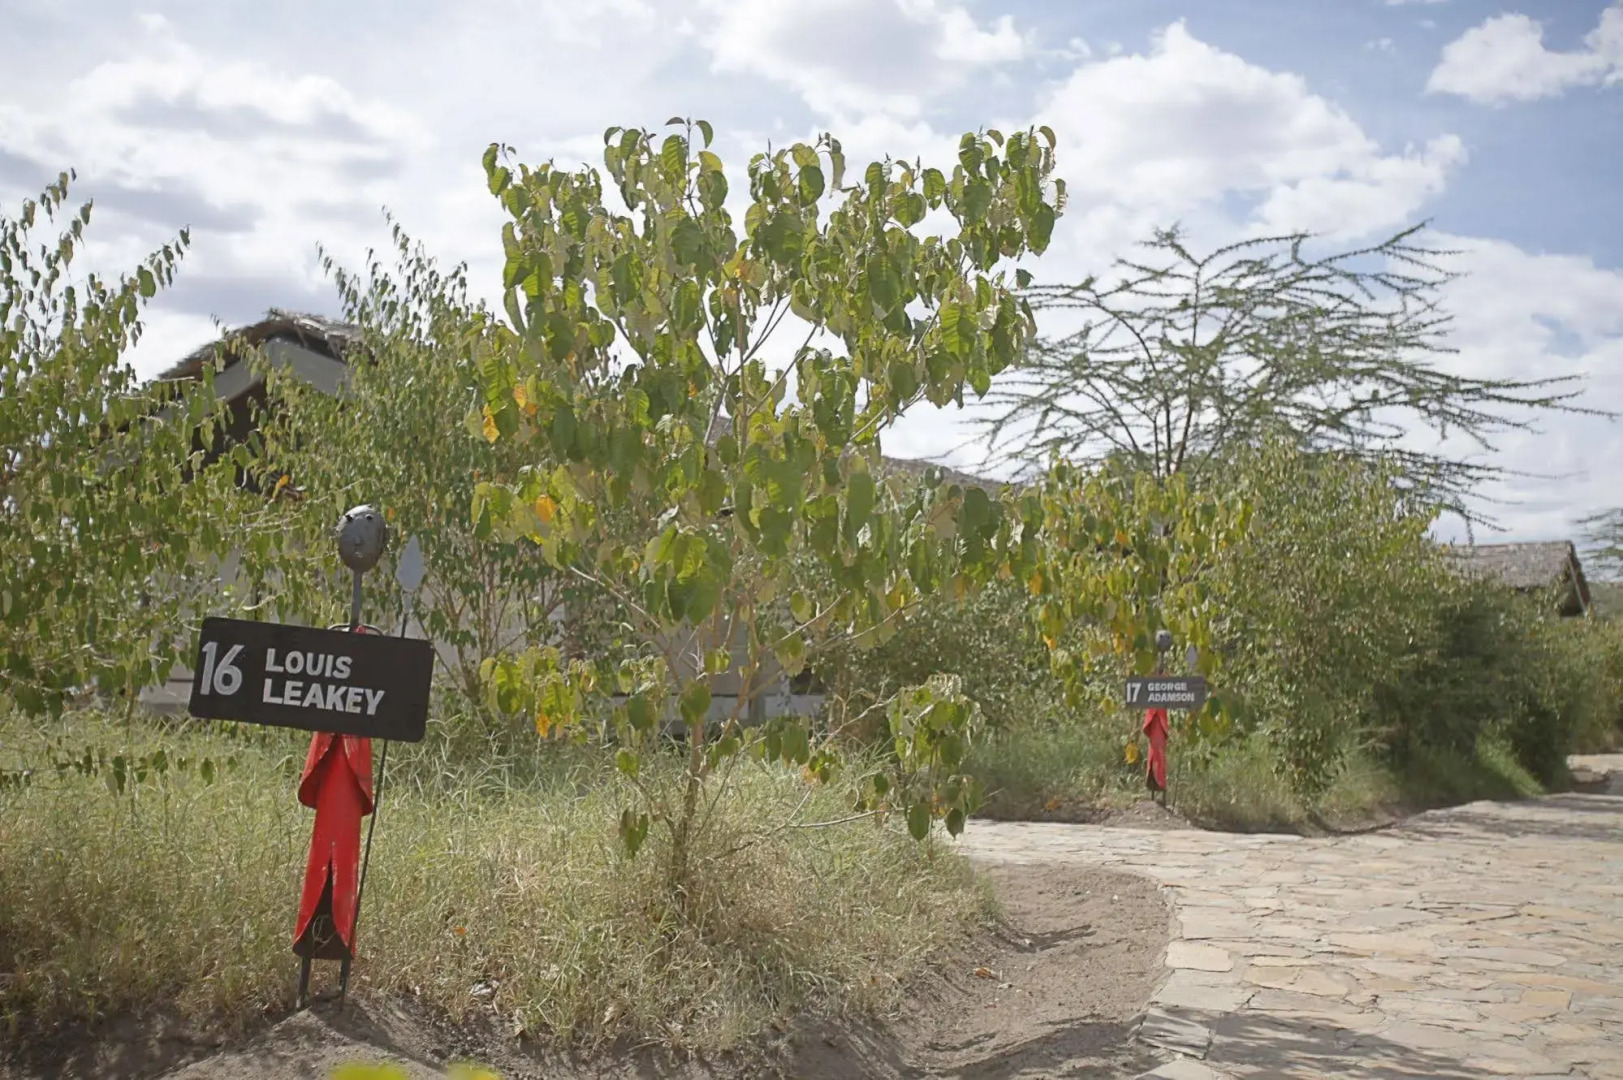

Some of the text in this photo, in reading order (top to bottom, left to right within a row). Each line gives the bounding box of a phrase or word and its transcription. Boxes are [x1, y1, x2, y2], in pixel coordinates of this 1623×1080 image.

[200, 641, 245, 696] 16
[265, 648, 353, 679] LOUIS
[262, 678, 385, 716] LEAKEY
[1126, 682, 1142, 703] 17
[1147, 682, 1187, 691] GEORGE
[1147, 692, 1195, 702] ADAMSON
